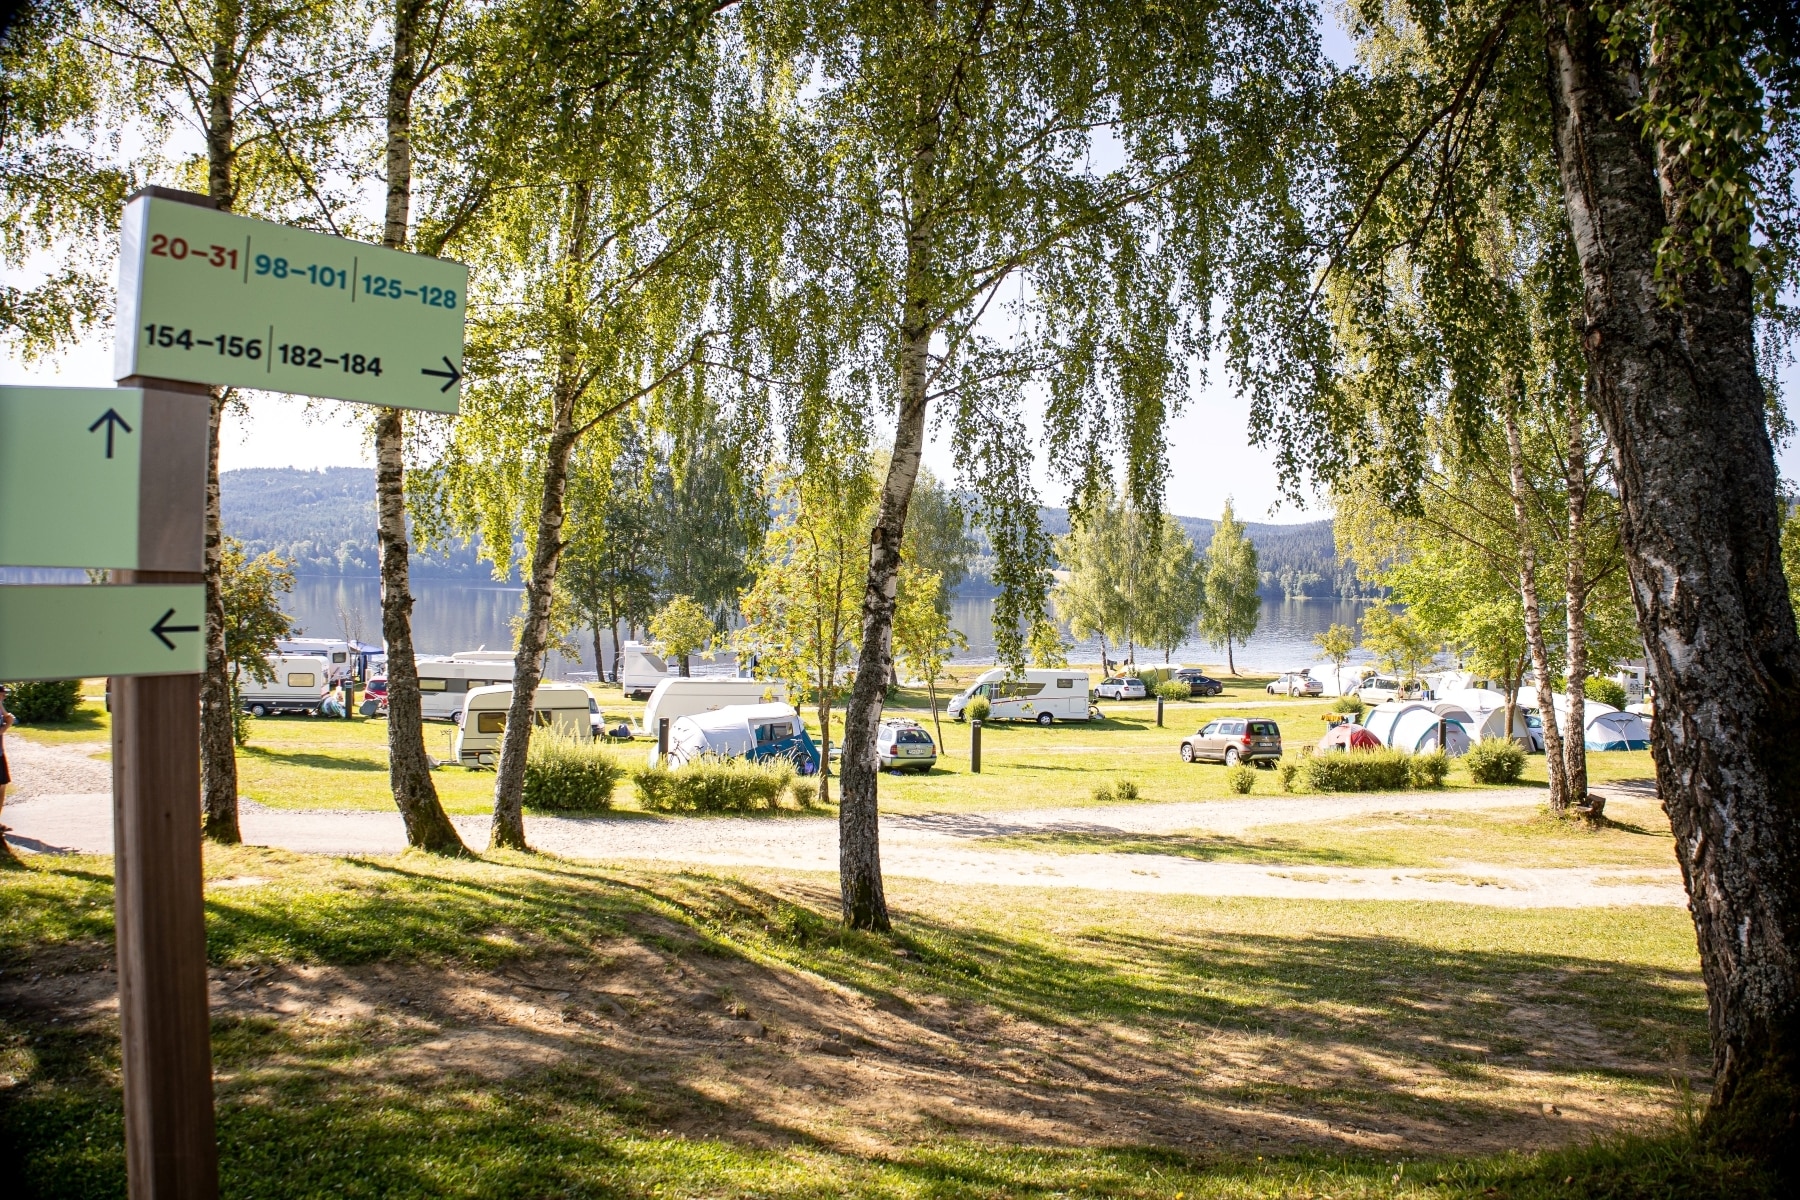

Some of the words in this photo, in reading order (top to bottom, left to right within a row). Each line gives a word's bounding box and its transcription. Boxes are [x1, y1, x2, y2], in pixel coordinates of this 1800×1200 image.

[150, 233, 239, 270] 20–31
[255, 254, 348, 290] 98–101
[361, 274, 457, 310] 125–128
[144, 323, 263, 361] 154–156
[278, 343, 383, 377] 182–184
